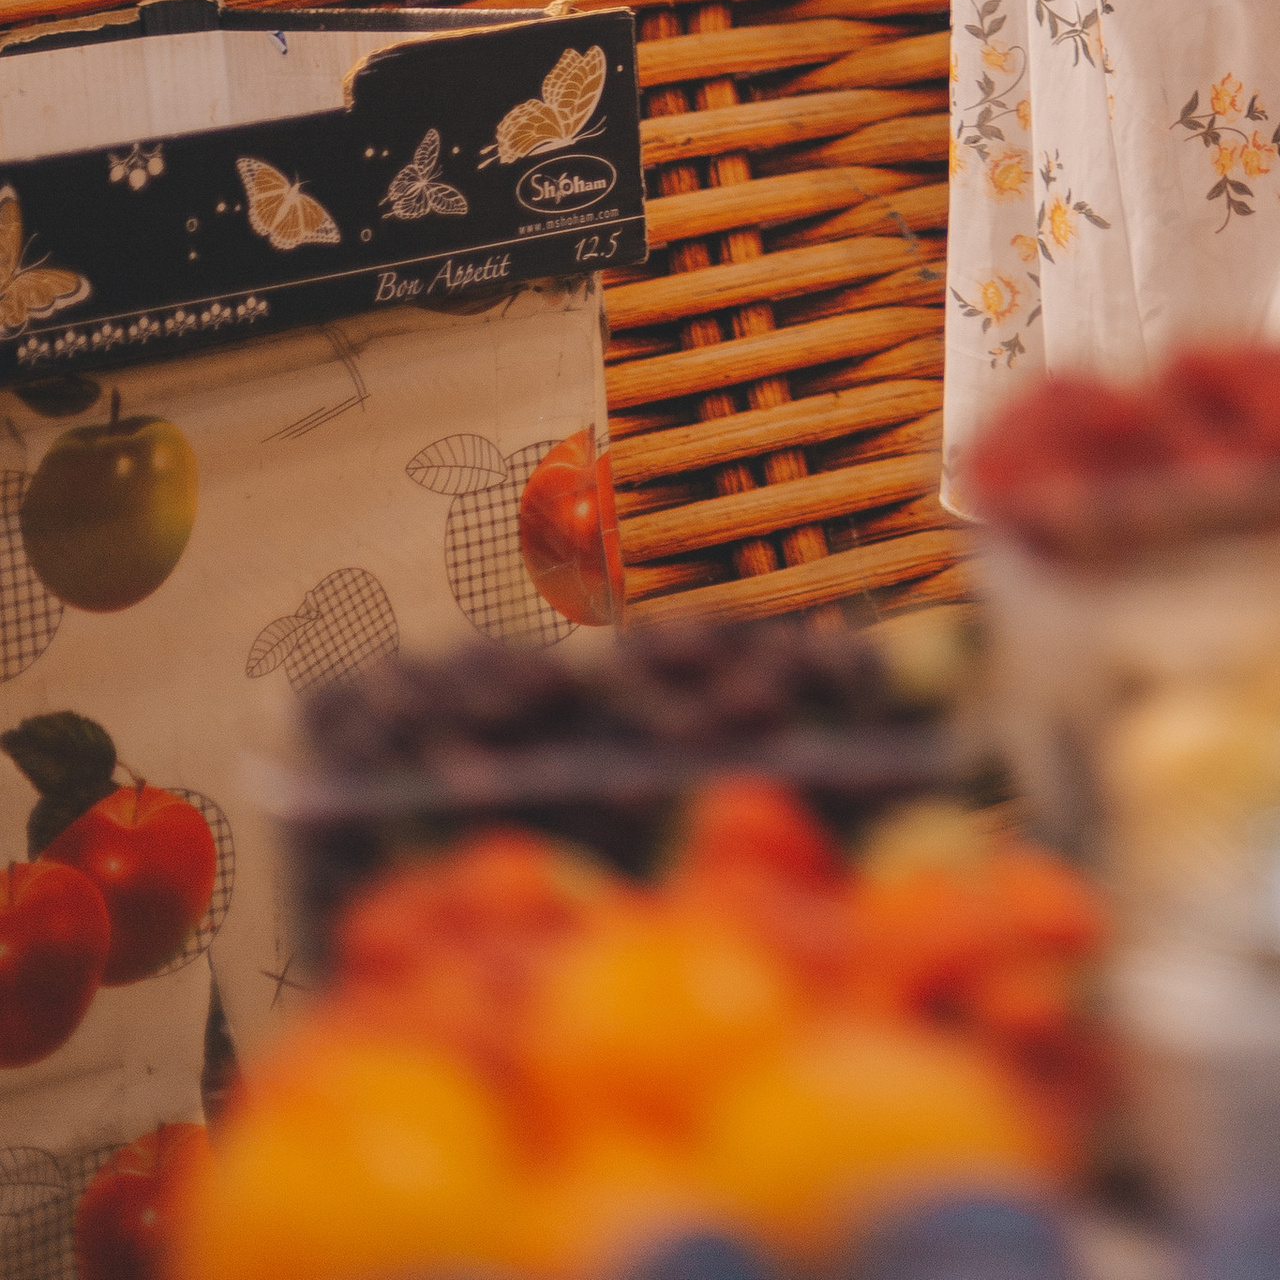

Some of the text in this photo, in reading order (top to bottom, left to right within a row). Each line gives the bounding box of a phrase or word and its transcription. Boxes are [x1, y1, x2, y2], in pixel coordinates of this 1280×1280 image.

[530, 172, 607, 204] Shoham
[575, 229, 622, 261] 12.5
[374, 253, 511, 302] Bon Appetit
